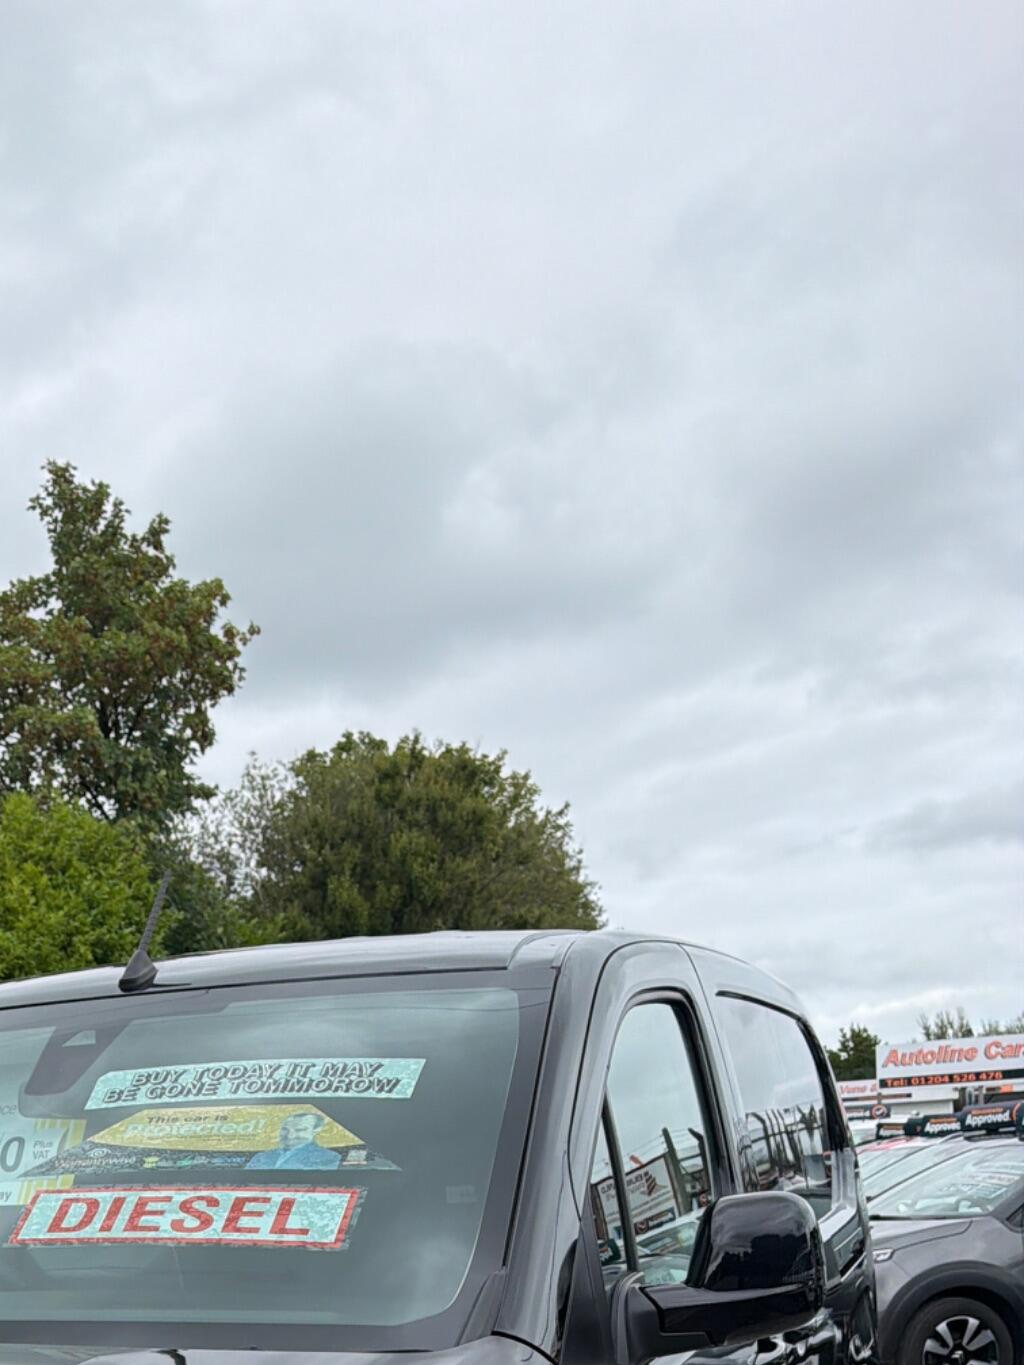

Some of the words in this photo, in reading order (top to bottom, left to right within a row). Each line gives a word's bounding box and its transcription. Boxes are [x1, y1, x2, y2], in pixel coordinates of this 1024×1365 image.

[882, 1044, 978, 1068] Autoline
[985, 1040, 1024, 1059] Car
[132, 1068, 185, 1087] BUY
[192, 1063, 280, 1083] TODAY
[287, 1062, 315, 1078] IT
[320, 1062, 384, 1078] MAY
[911, 1075, 949, 1086] 01204
[103, 1087, 140, 1104] BE
[145, 1080, 220, 1099] GONE
[230, 1077, 401, 1094] TOMMOROW
[32, 1150, 51, 1160] VAT
[46, 1195, 311, 1236] DIESEL
